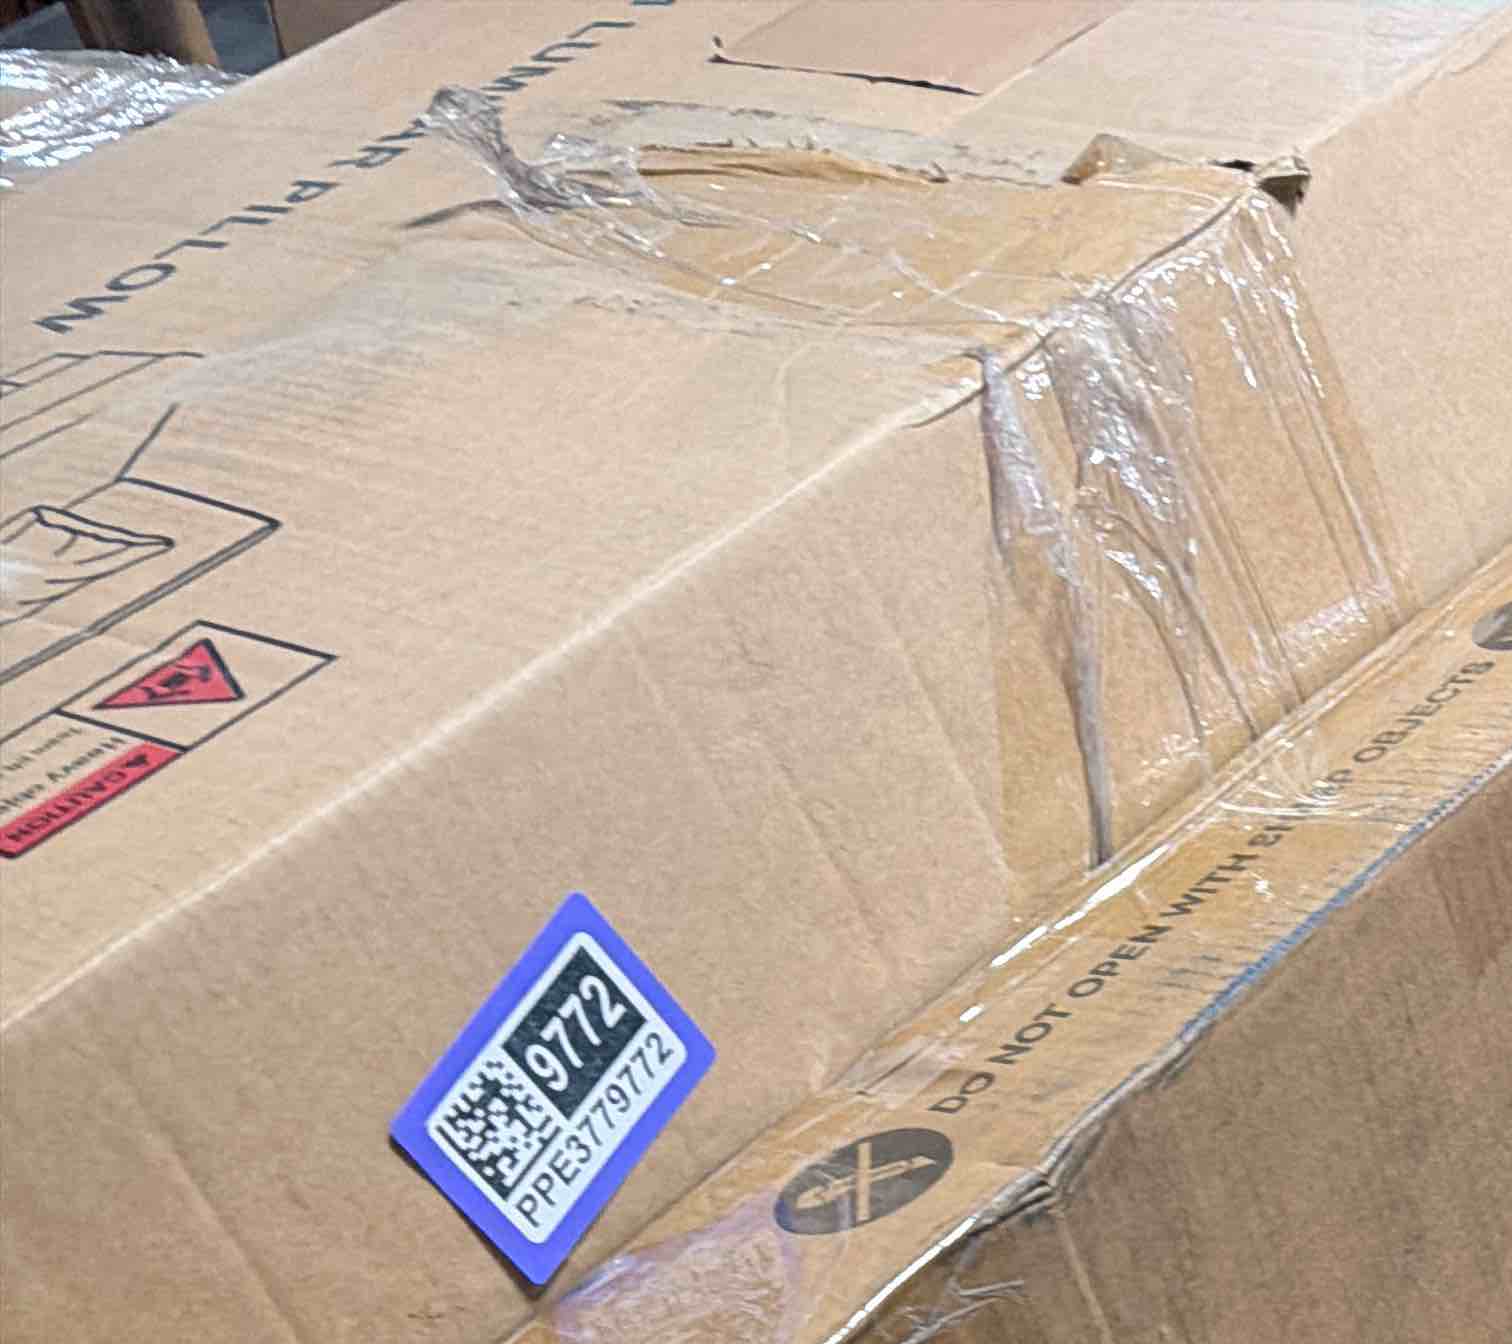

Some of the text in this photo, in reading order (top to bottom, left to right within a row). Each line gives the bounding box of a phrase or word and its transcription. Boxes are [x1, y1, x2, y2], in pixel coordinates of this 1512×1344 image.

[35, 20, 635, 334] LUMAR PILLOW
[6, 770, 128, 844] CAUTION
[930, 1071, 994, 1114] DO
[990, 1004, 1073, 1065] NOT
[1068, 924, 1170, 999] OPEN
[1163, 853, 1259, 919] WITH
[1353, 660, 1497, 764] OBJECTS
[515, 1031, 675, 1228] PPE3779772
[525, 974, 627, 1093] 9772
